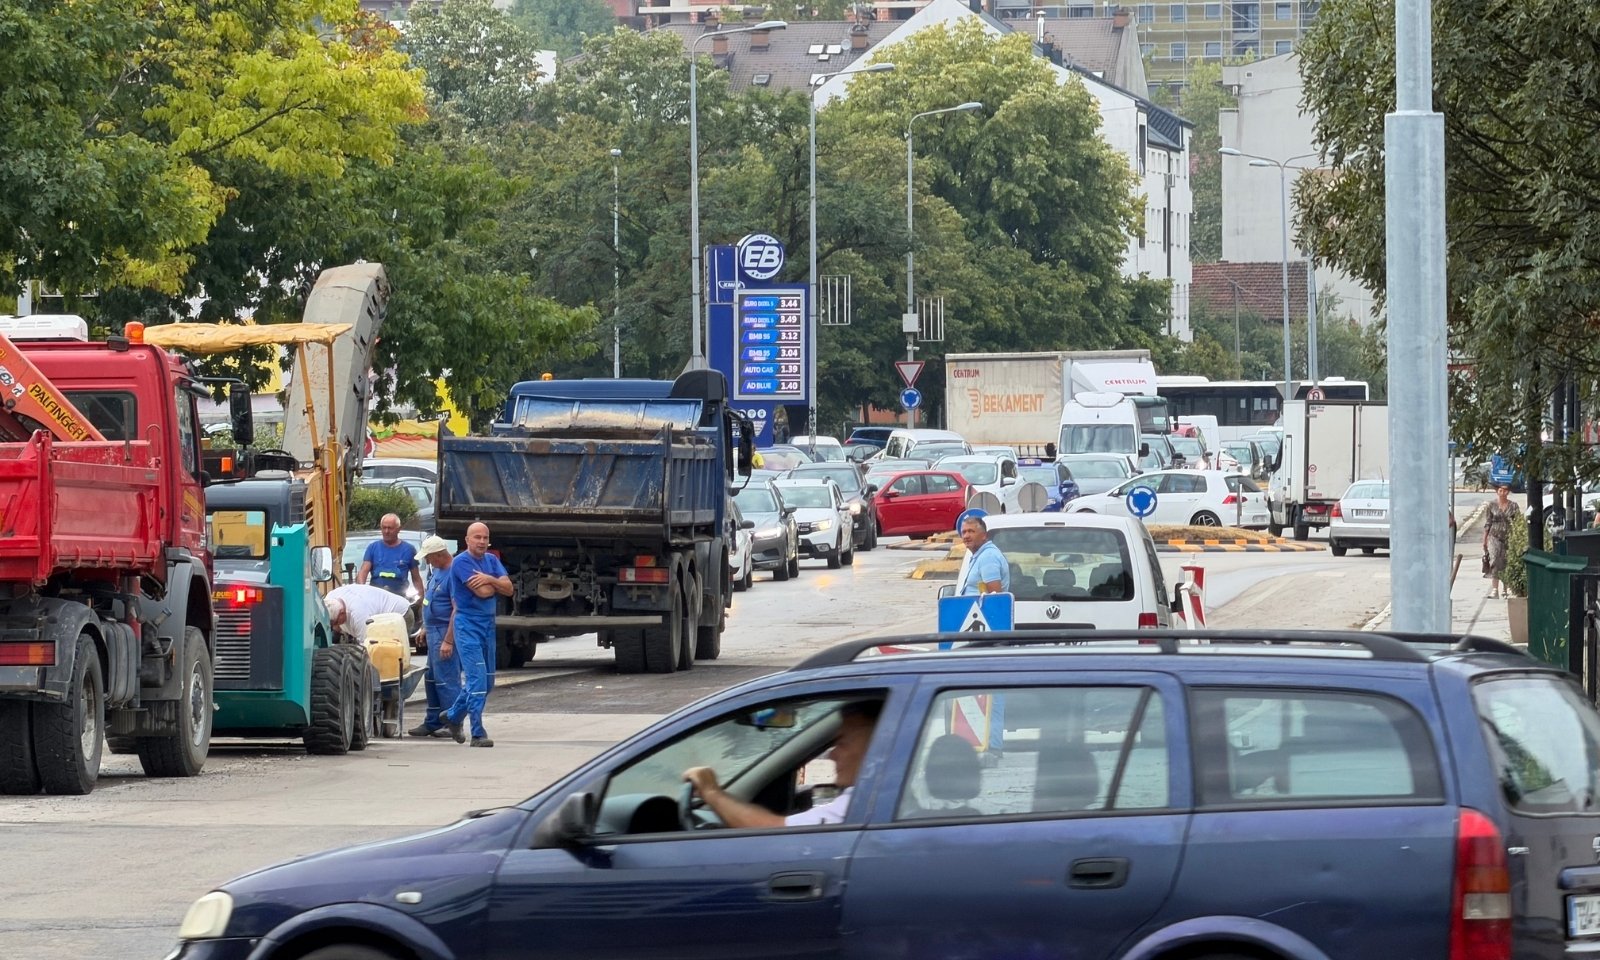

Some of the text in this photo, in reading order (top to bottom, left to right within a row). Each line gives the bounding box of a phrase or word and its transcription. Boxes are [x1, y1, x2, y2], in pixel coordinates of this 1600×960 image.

[744, 245, 780, 268] EB
[780, 315, 798, 323] 3.49
[781, 332, 798, 340] 3.12
[748, 349, 763, 357] BMB
[781, 348, 798, 357] 3.04
[781, 365, 798, 373] 1.39
[953, 369, 980, 378] CENTRUM
[781, 381, 798, 390] 1.40
[983, 393, 1045, 413] BEKAMENT
[29, 384, 84, 440] PALFINGER
